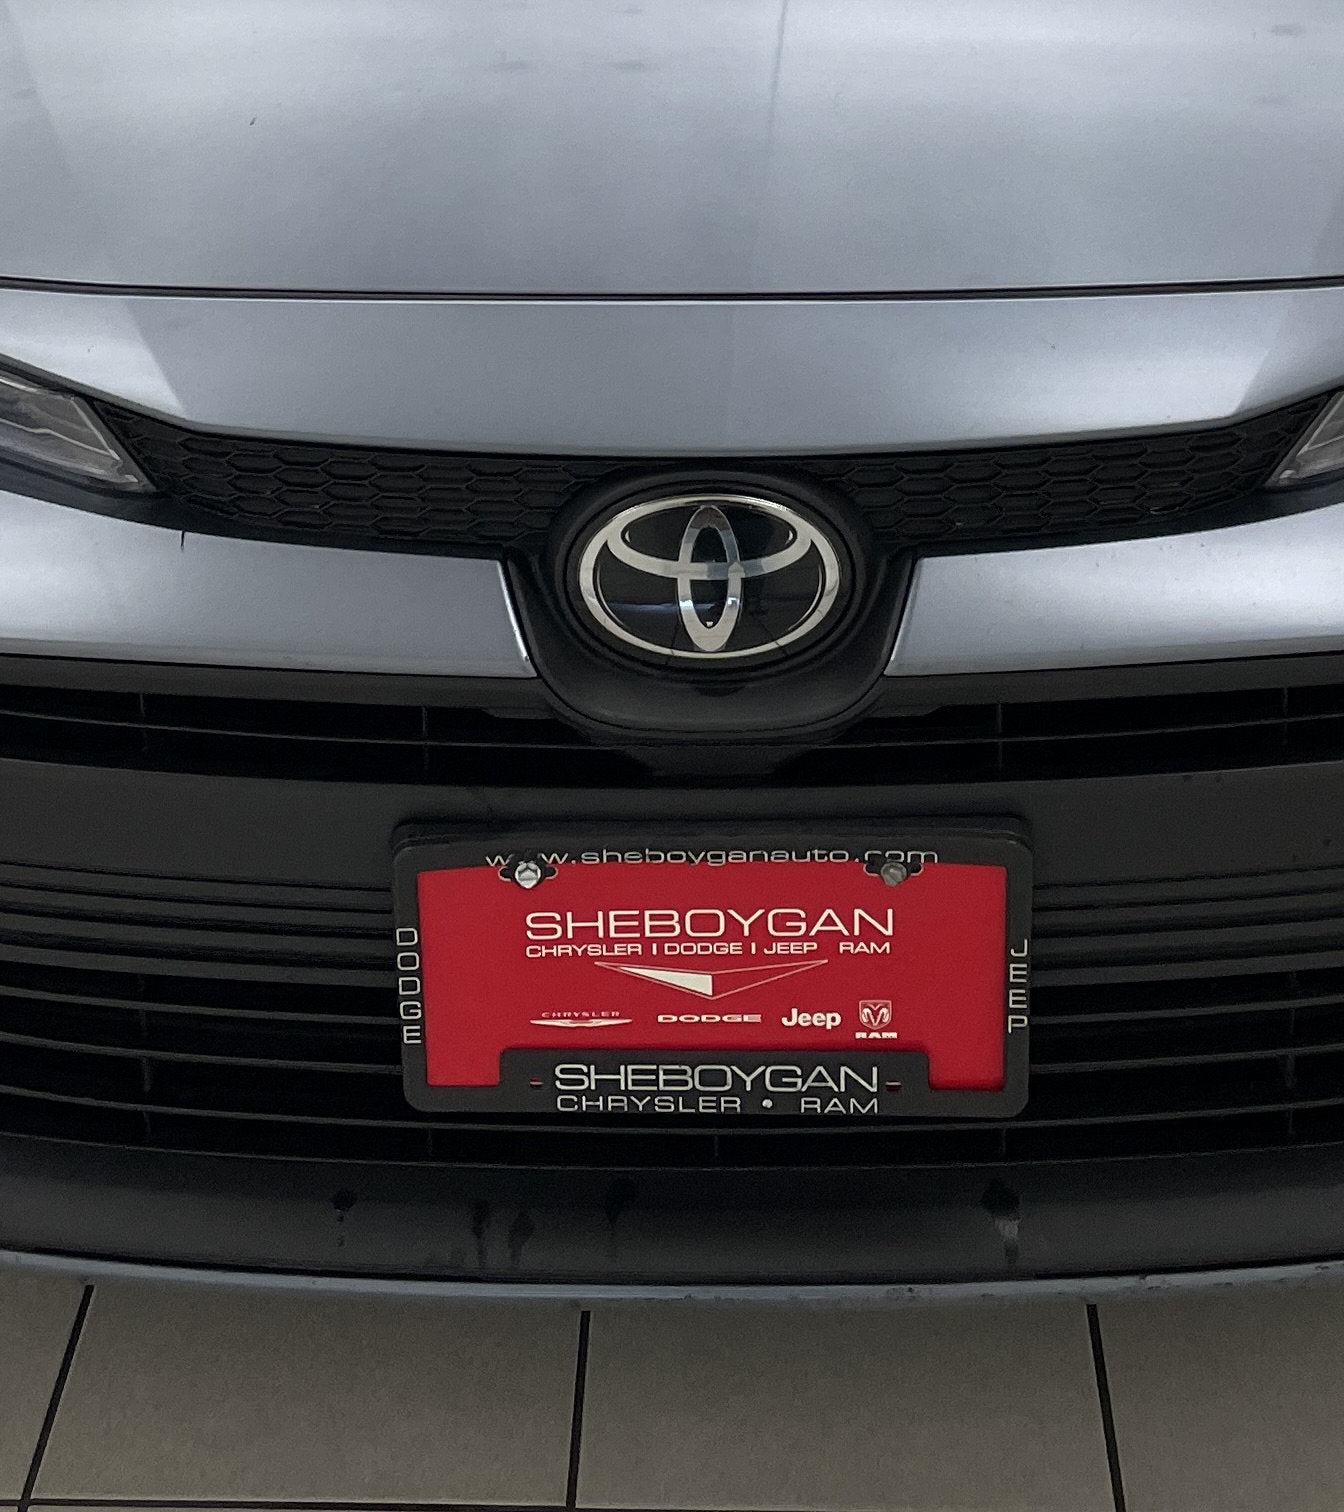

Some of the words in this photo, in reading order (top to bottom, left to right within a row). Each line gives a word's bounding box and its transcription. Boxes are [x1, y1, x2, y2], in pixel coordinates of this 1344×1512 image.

[485, 848, 939, 867] ww.sheboyganauto.com
[525, 908, 894, 941] SHEBOYGAN
[525, 943, 643, 958] CHRYSLER
[664, 942, 744, 956] DODGE
[763, 941, 818, 955] JEEP
[839, 941, 891, 954] RAM
[396, 928, 422, 1044] DODGE
[1007, 938, 1029, 1034] JEEP
[657, 1014, 763, 1023] DODGE
[781, 1007, 842, 1030] Jeep
[855, 1031, 898, 1039] RAM
[554, 1063, 878, 1093] SHEBOYGAN
[556, 1095, 741, 1113] CHRYSLER
[801, 1097, 878, 1114] RAM
